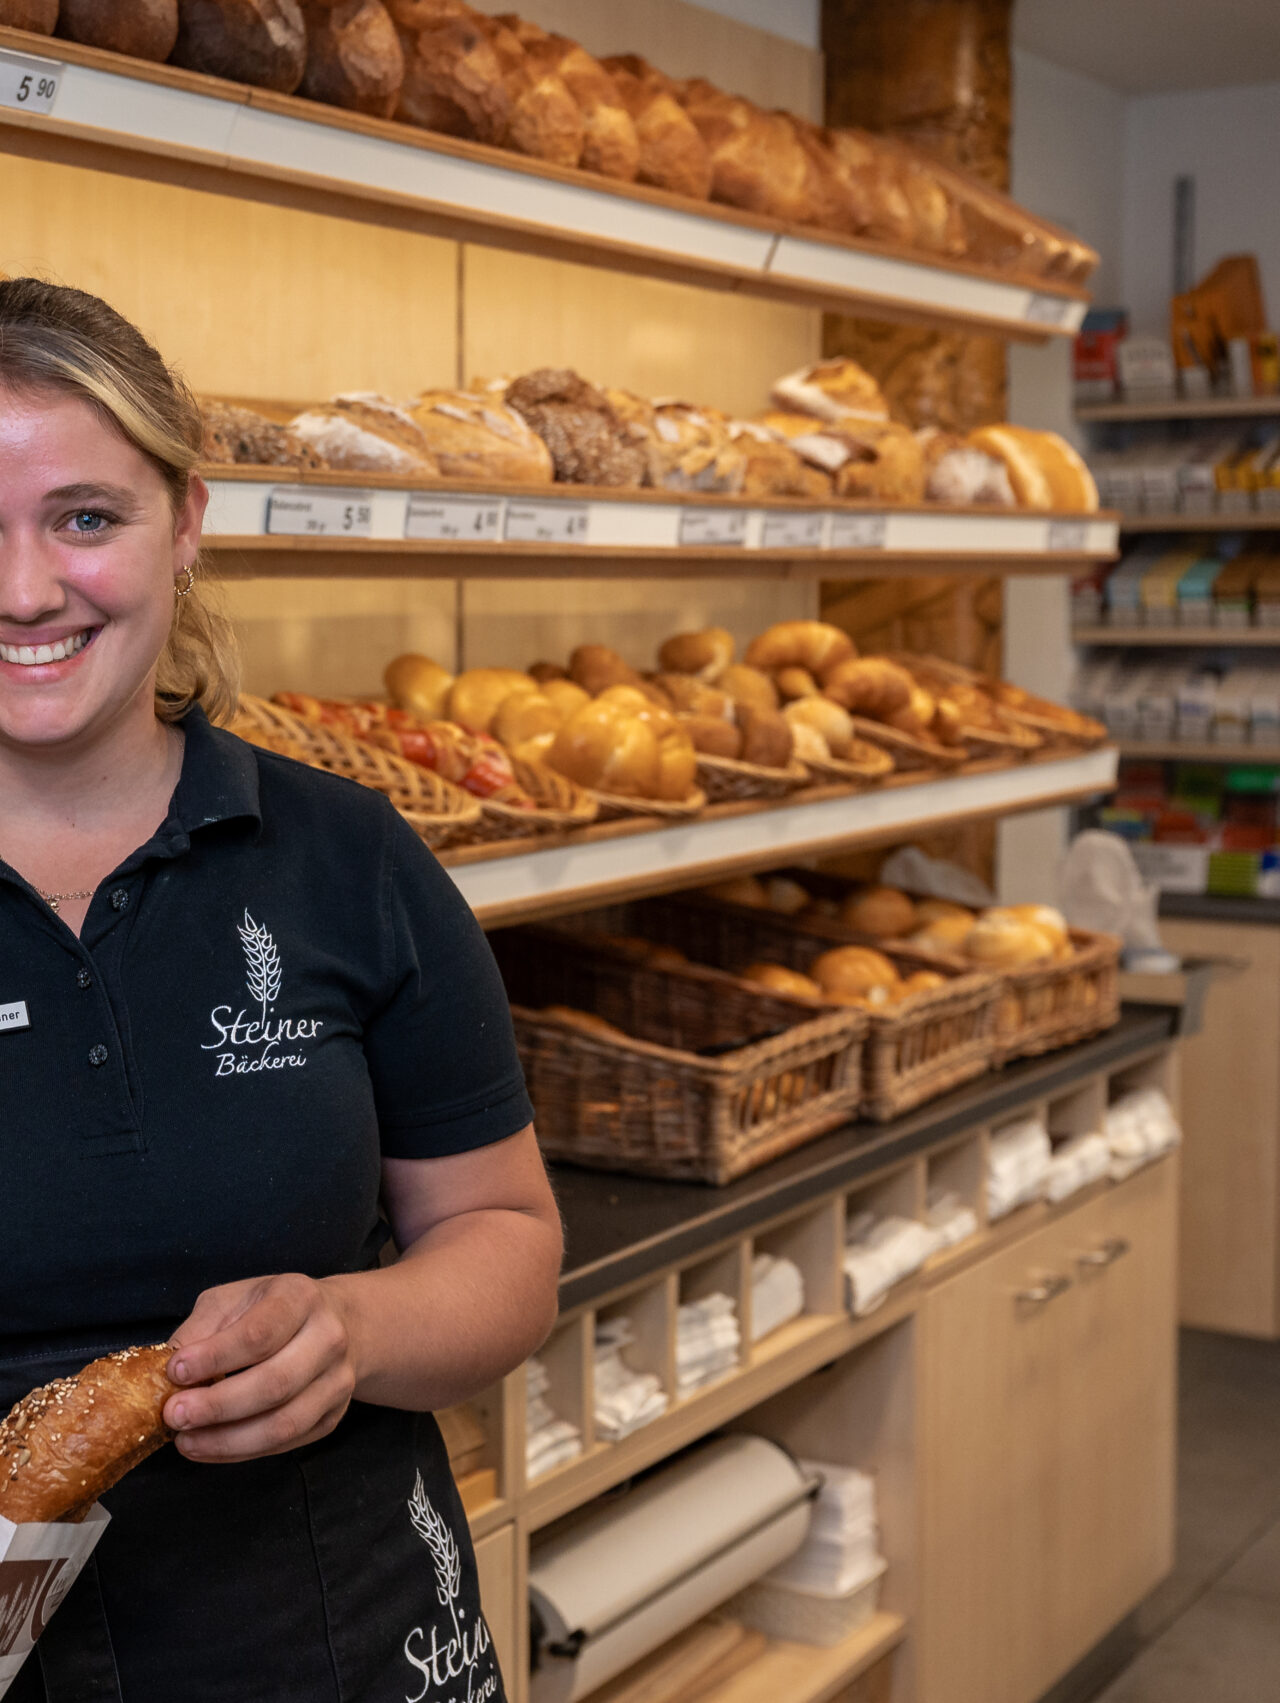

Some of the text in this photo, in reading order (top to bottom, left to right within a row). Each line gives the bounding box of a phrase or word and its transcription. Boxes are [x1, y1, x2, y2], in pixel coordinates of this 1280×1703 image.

[16, 75, 56, 101] 5 90
[201, 1005, 324, 1049] Steiner
[214, 1041, 307, 1077] Bäckerei
[404, 1608, 490, 1703] Stein
